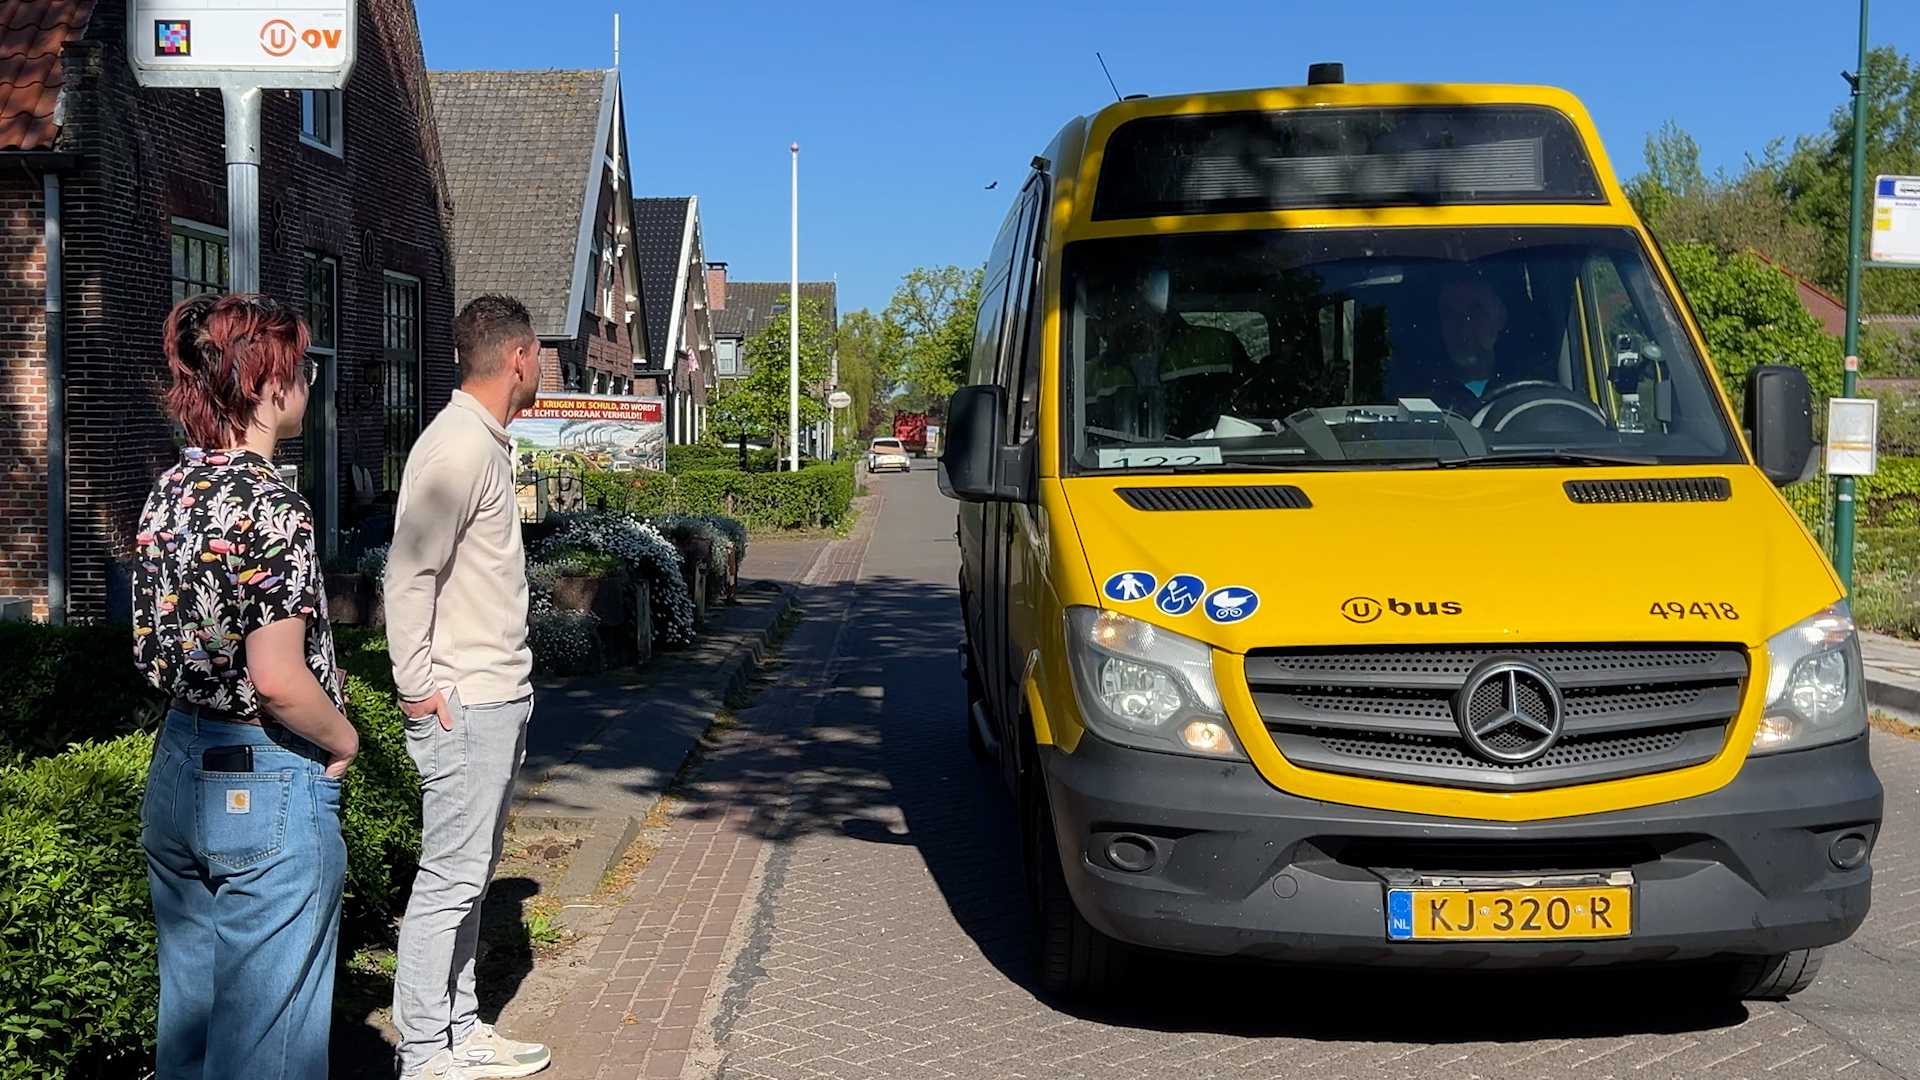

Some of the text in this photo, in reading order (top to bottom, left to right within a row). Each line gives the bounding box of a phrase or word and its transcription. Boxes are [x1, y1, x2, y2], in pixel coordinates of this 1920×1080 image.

[301, 29, 342, 49] OV
[522, 409, 643, 420] DE ECHTE OORZAAK VERHULD!!
[576, 401, 587, 409] DE
[588, 401, 619, 410] SCHULD,
[631, 404, 657, 412] WORDT
[1387, 598, 1463, 616] bus
[1649, 602, 1740, 620] 49418
[1393, 897, 1613, 931] NL KJ 320 R
